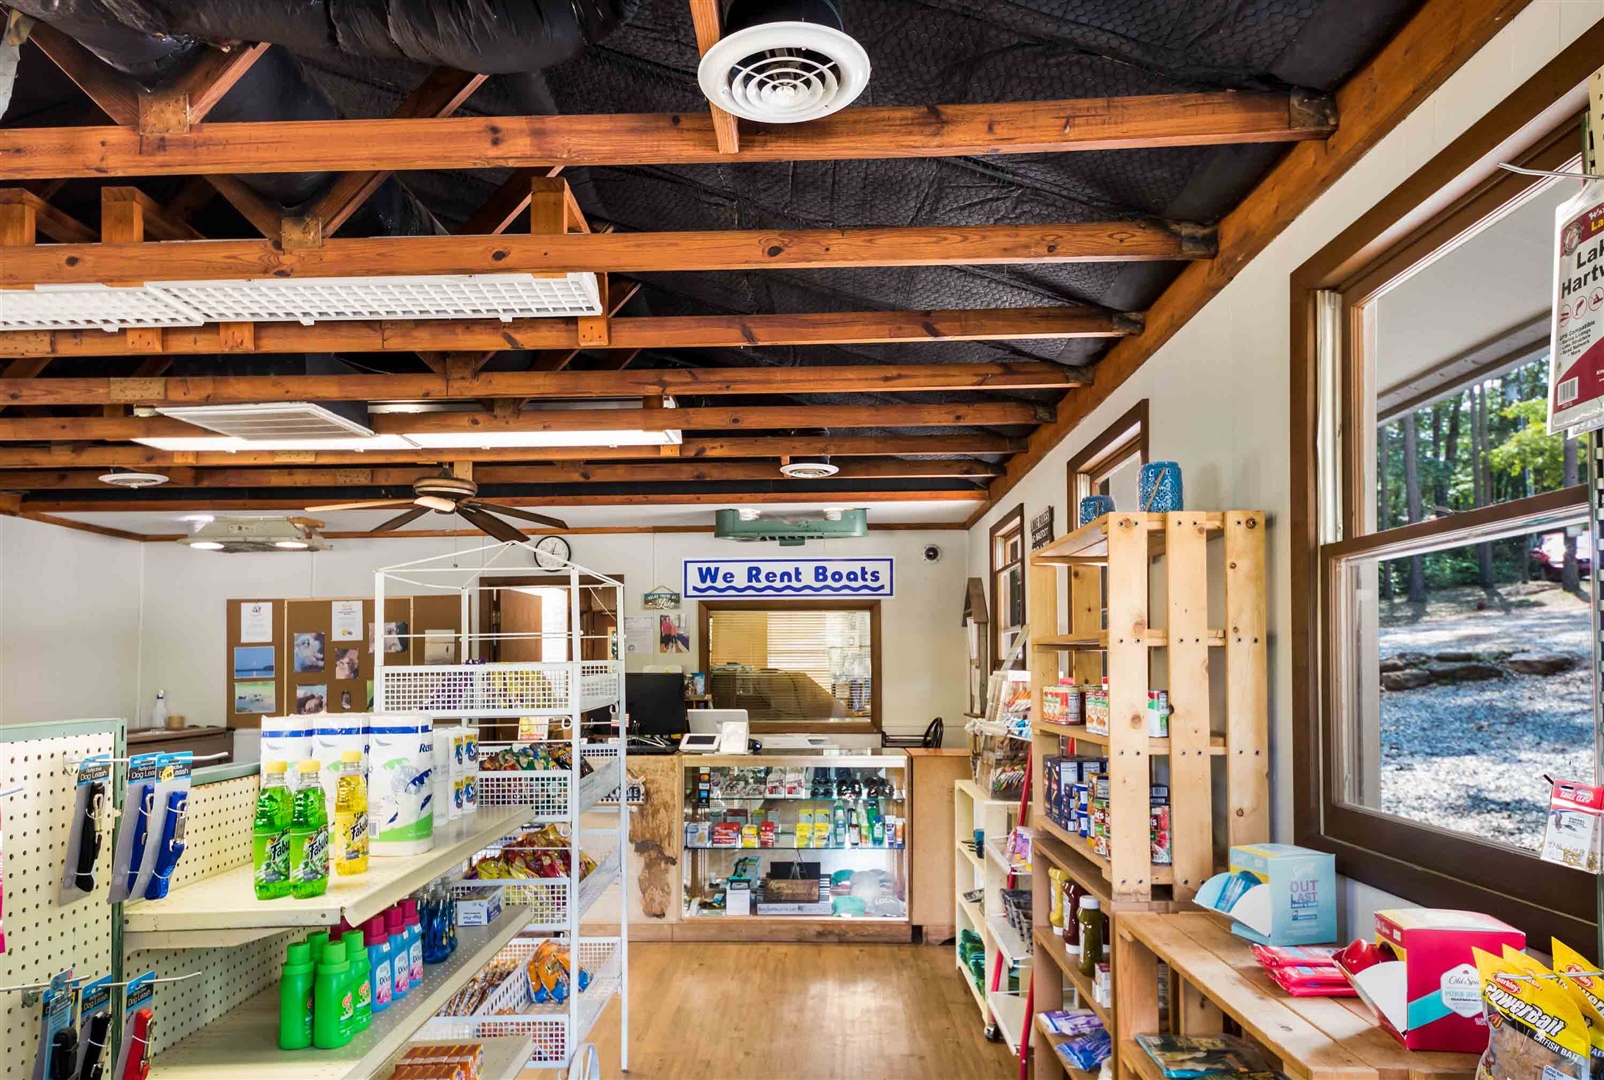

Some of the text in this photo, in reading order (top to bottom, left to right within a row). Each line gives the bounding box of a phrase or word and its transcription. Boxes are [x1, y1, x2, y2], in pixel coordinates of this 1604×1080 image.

[1569, 320, 1595, 335] Compatible
[697, 565, 880, 584] We Rent Boats
[80, 770, 107, 782] Dog Leash
[131, 772, 143, 781] Dog
[145, 768, 156, 777] Lea
[174, 769, 188, 777] eash
[1290, 880, 1318, 892] OUT
[1291, 892, 1317, 903] LAST
[1485, 978, 1567, 1037] PowerBait
[1533, 1033, 1580, 1062] CATFISH BAIT
